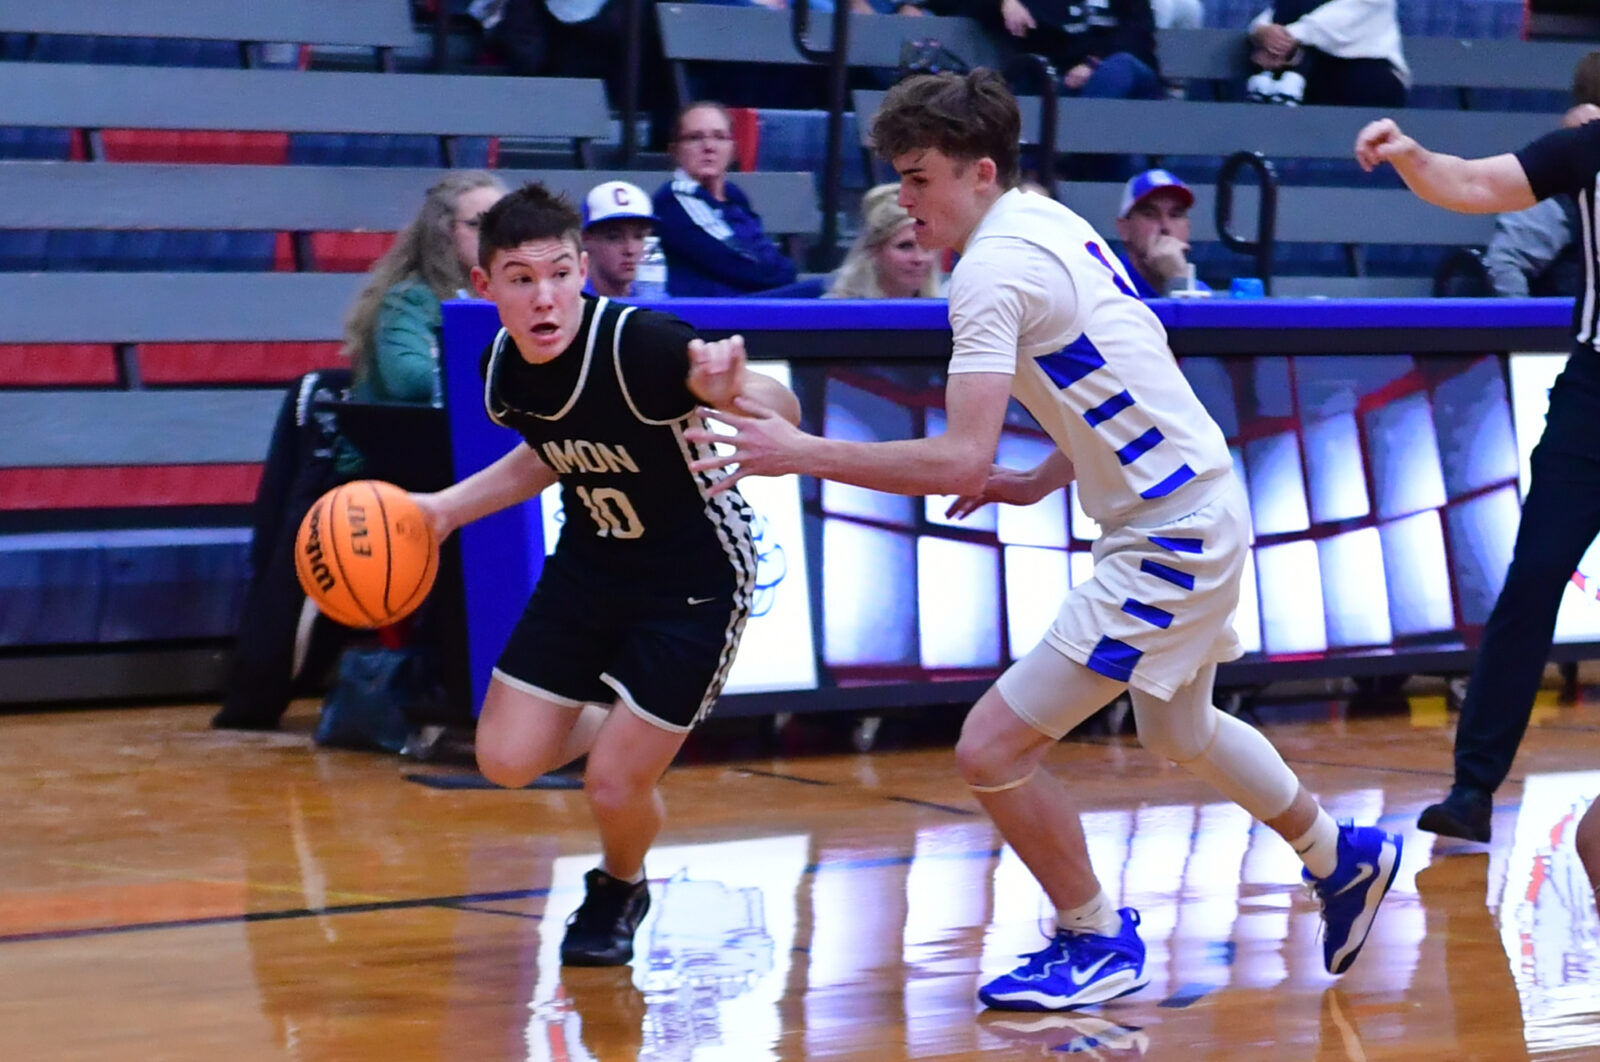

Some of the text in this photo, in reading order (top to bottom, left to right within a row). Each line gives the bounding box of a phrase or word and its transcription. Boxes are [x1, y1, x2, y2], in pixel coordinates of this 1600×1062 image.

[614, 188, 630, 206] C
[542, 439, 641, 474] IMON
[576, 485, 645, 539] 10
